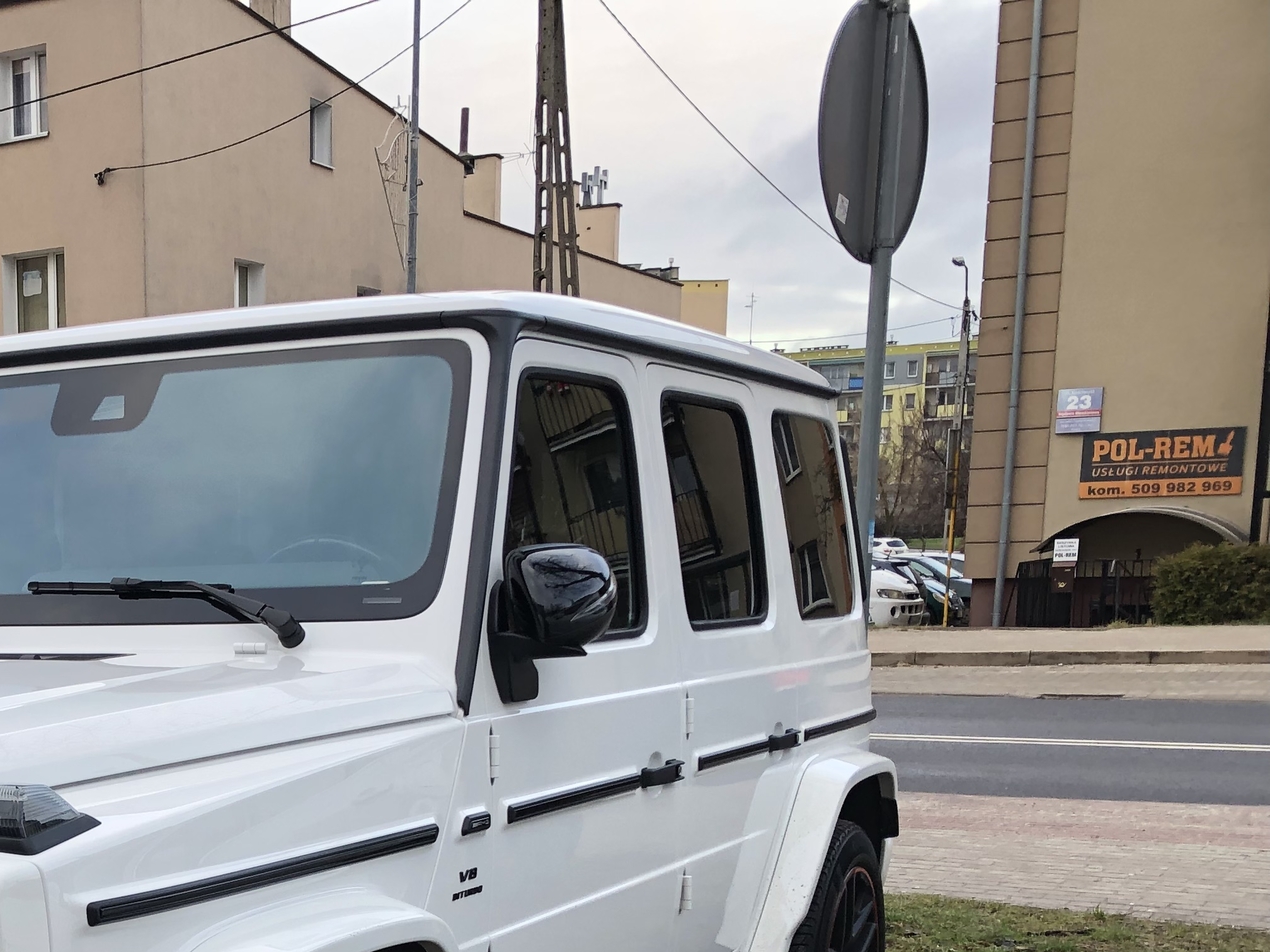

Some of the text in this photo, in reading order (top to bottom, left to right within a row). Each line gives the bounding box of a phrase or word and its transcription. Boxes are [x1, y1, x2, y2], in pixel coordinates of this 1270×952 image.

[1066, 395, 1092, 410] 23
[1092, 435, 1217, 462] POL-REM
[1091, 463, 1228, 478] USŁUGI REMONTOWE
[1087, 480, 1233, 496] kom. 509 982 969
[459, 867, 478, 883] V8
